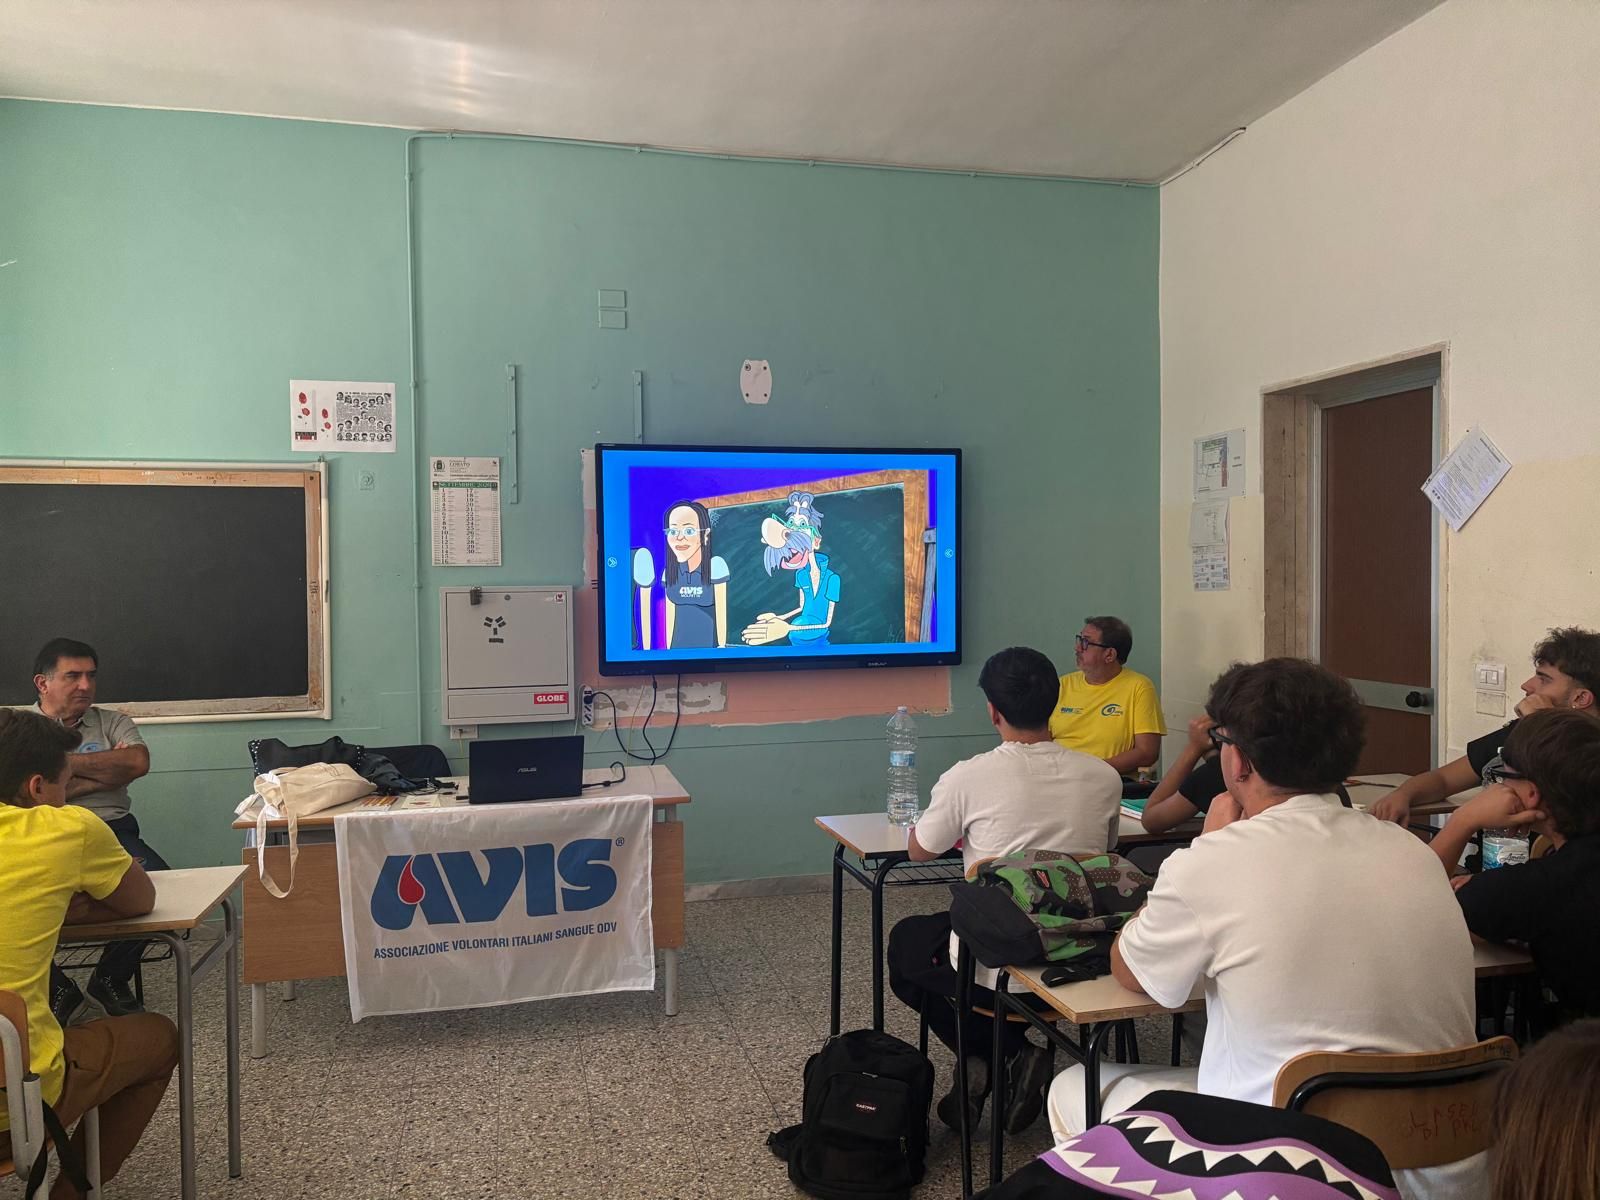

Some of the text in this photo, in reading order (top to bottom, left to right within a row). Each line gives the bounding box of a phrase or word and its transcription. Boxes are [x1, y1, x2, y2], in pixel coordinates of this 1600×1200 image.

[370, 838, 618, 930] AVIS
[374, 922, 618, 960] ASSOCIAZIONE VOLONTARI ITALIANI SANGUE ODV
